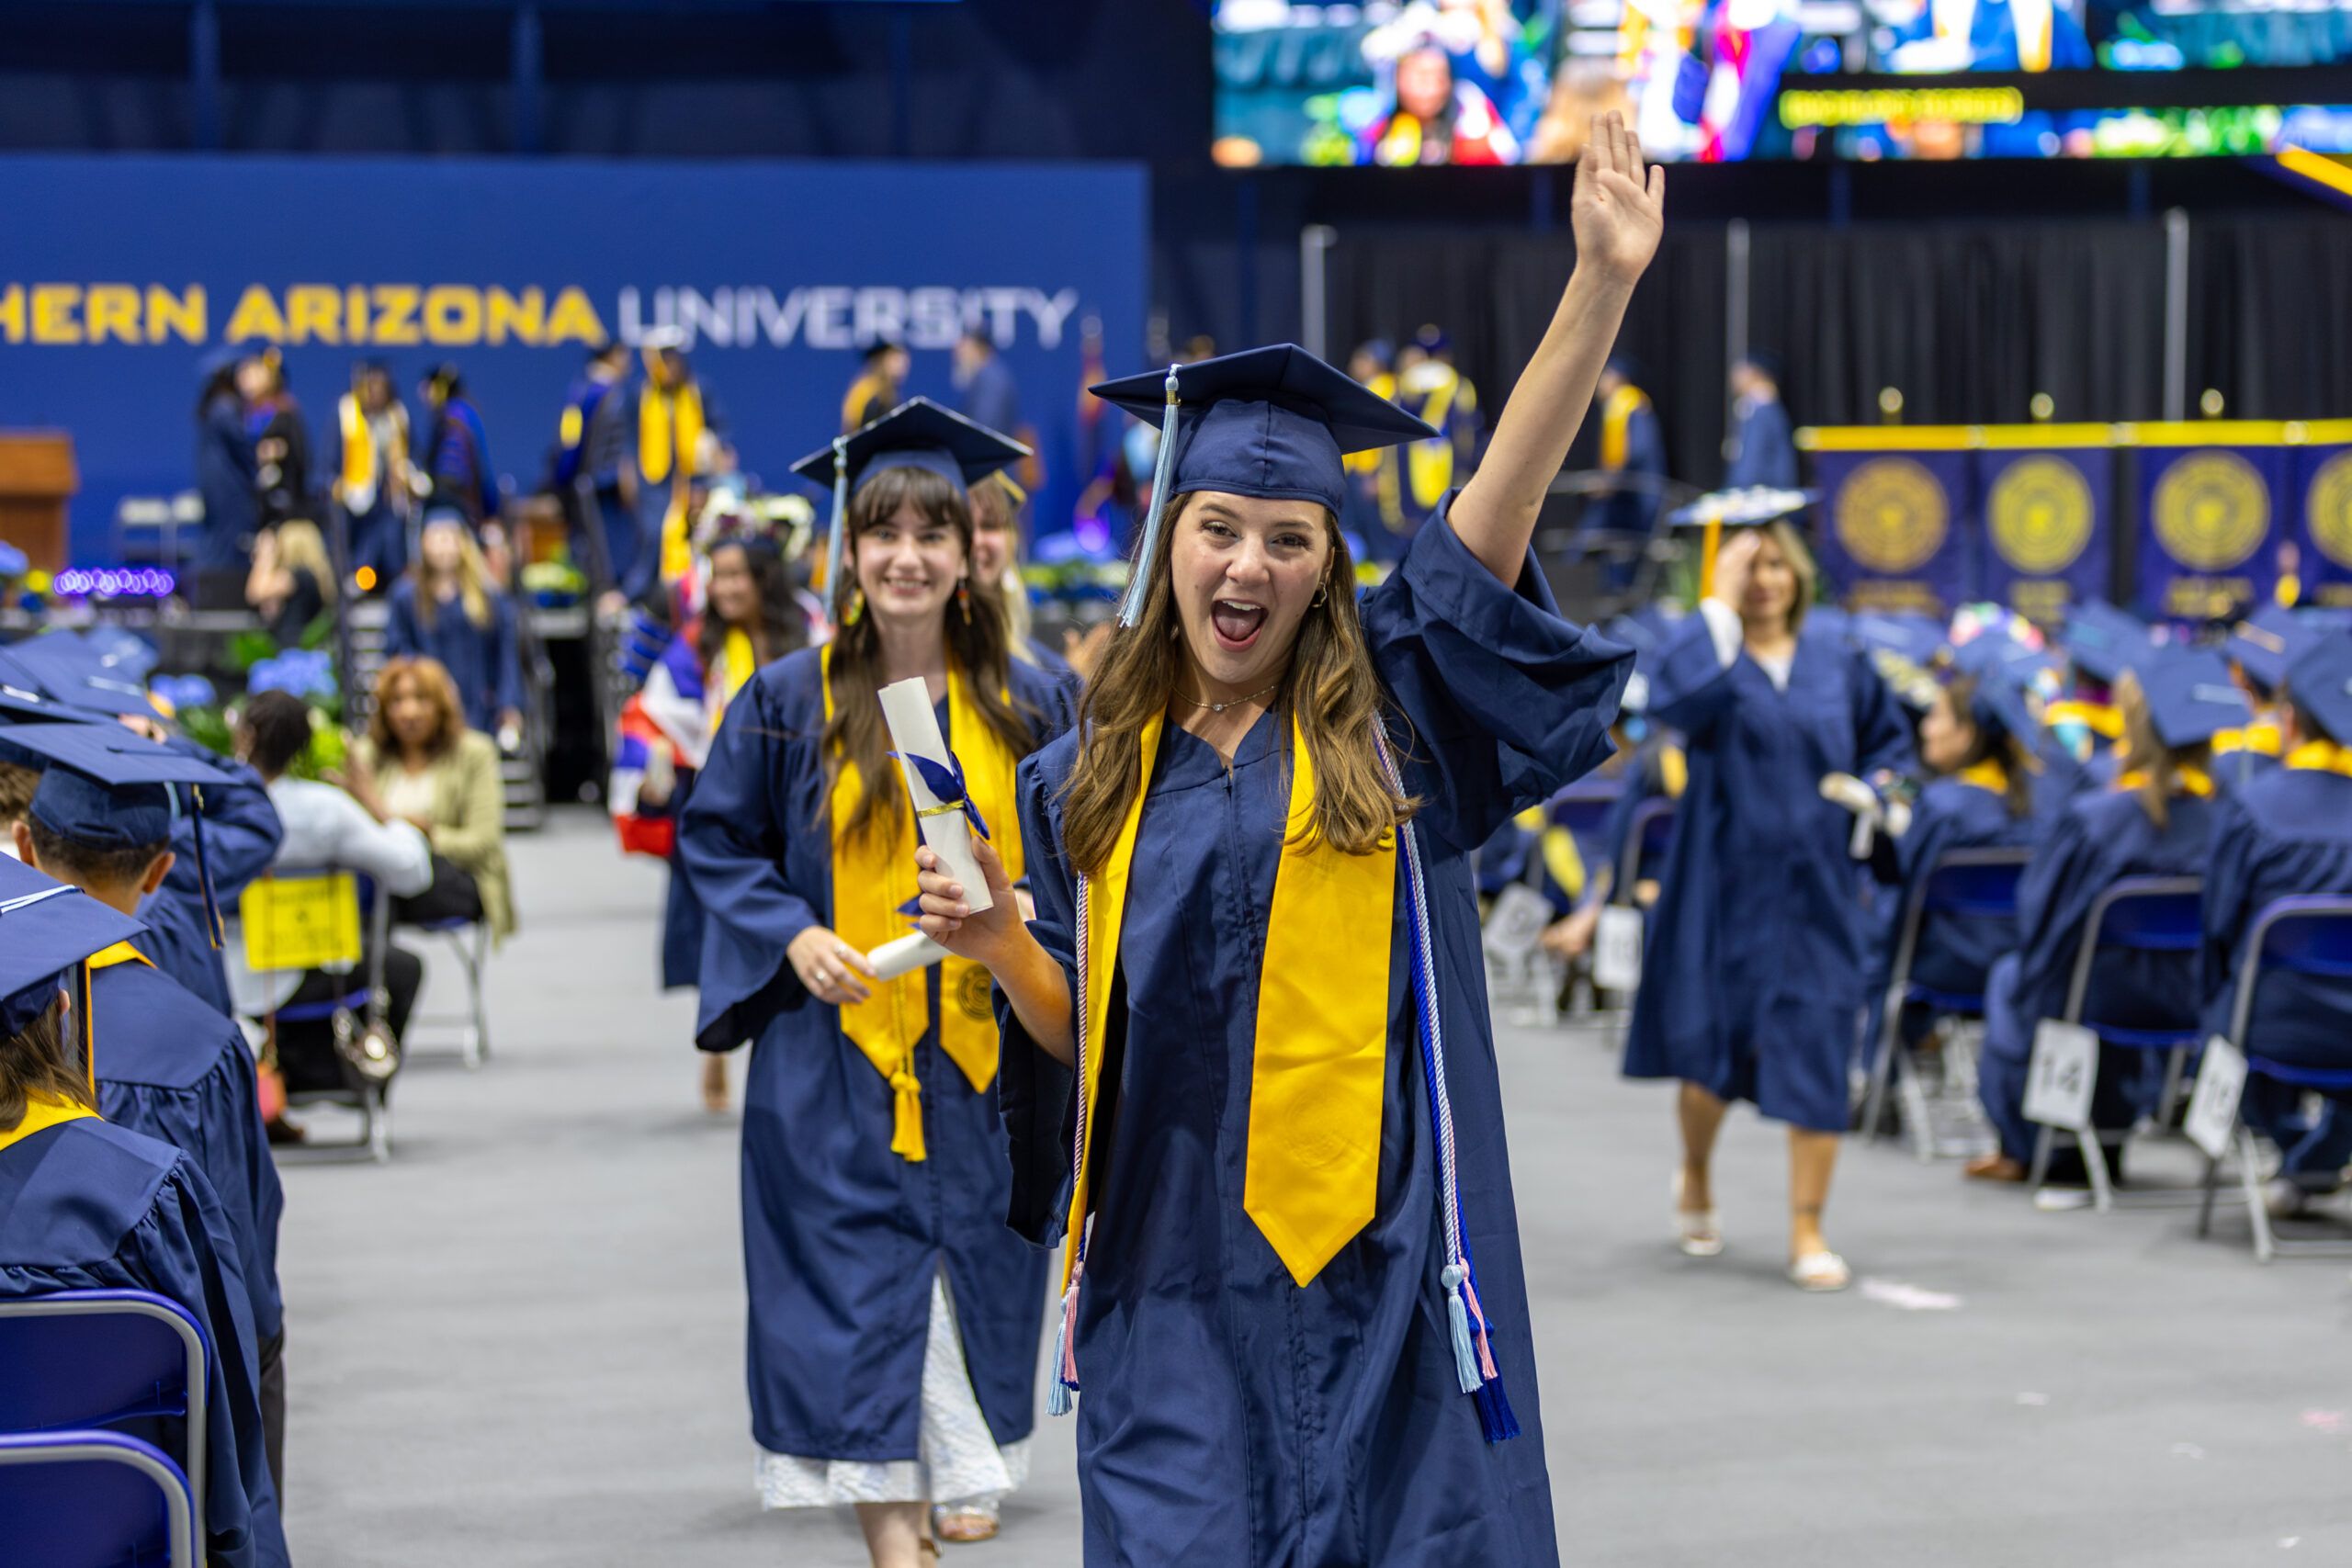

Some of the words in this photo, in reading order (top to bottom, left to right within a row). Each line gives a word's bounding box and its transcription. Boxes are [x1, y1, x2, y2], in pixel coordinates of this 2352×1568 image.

[226, 284, 605, 345] ARIZONA
[618, 286, 1079, 348] UNIVERSITY
[2041, 1053, 2083, 1097] 14
